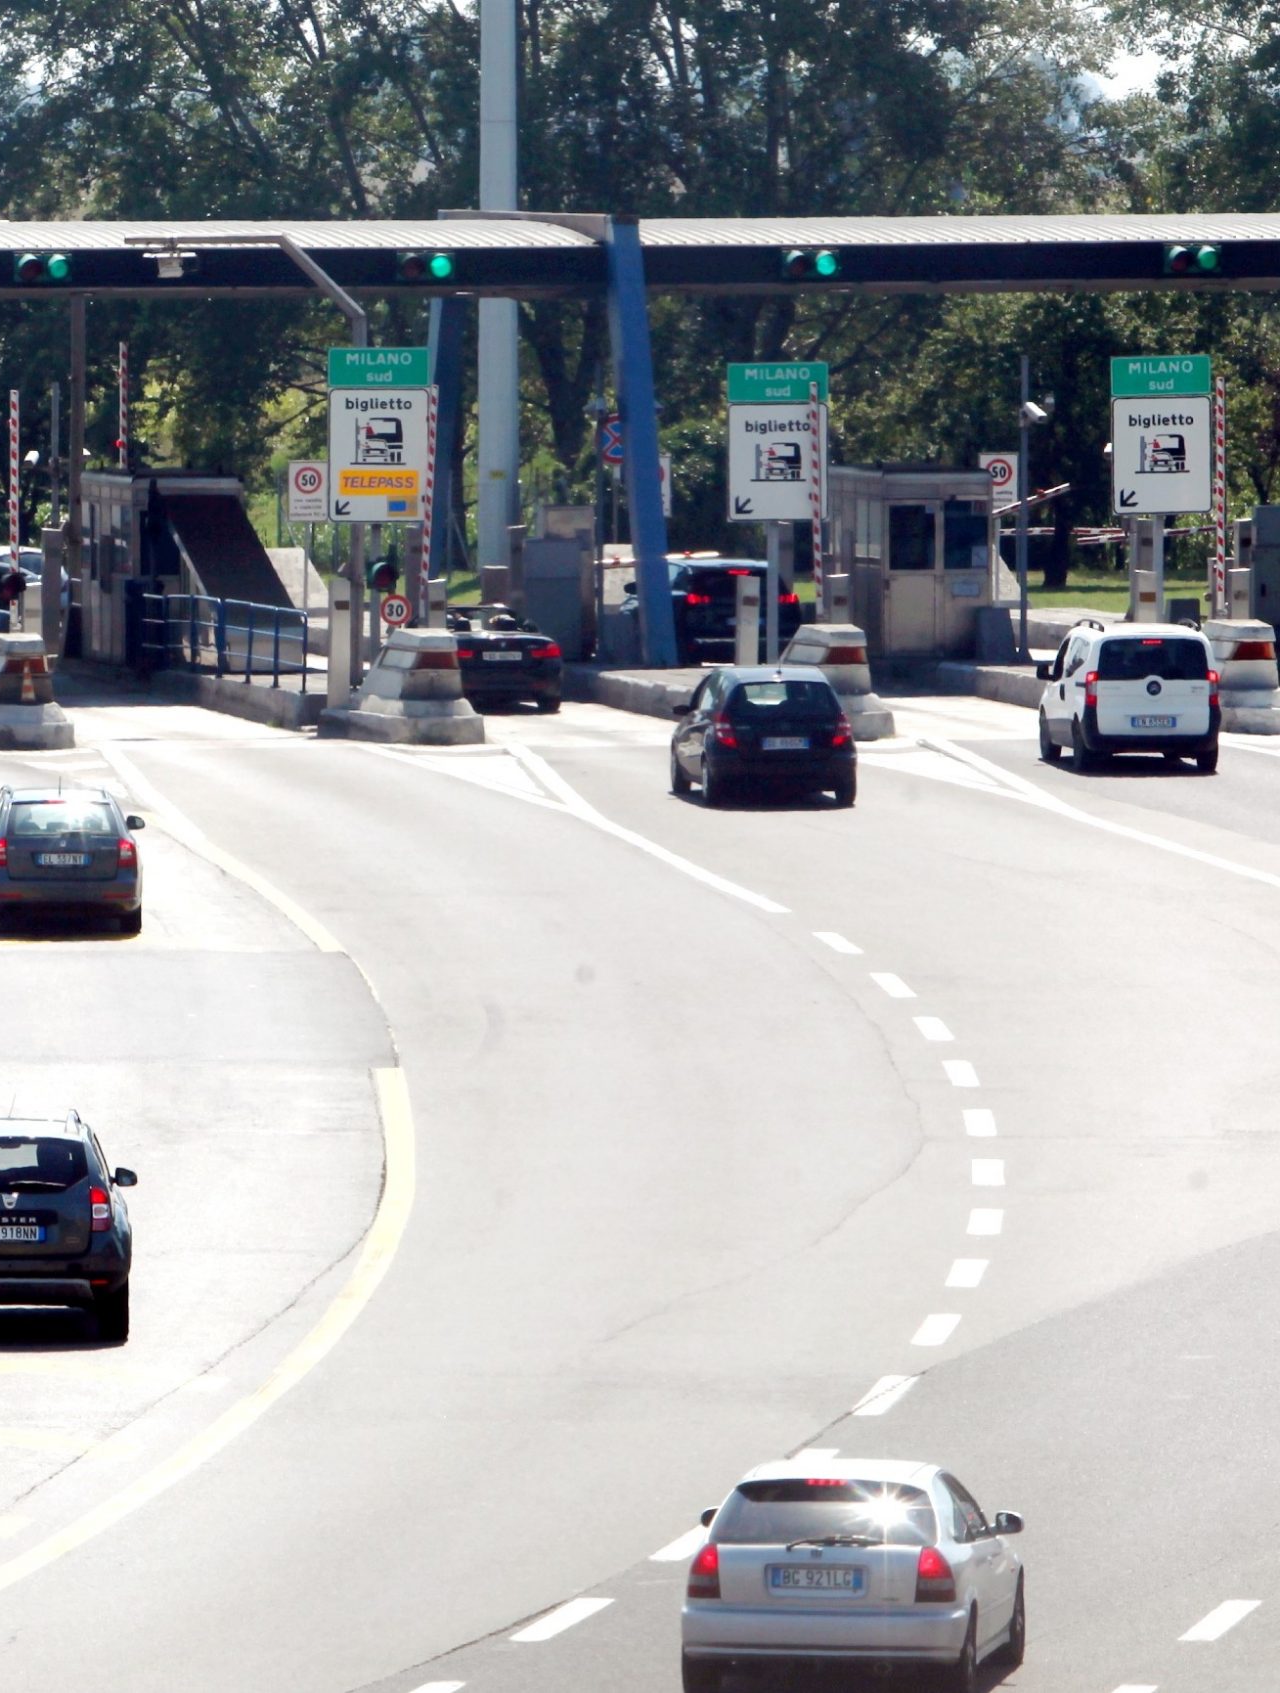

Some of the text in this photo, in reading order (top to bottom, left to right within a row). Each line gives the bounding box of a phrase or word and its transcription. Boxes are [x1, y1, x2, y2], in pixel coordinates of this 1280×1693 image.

[345, 352, 412, 365] MILANO
[1128, 360, 1194, 374] MILANO
[366, 370, 393, 382] sud
[744, 367, 811, 381] MILANO
[765, 384, 791, 397] sud
[1148, 378, 1175, 390] sud
[345, 397, 412, 412] biglietto
[744, 419, 811, 435] biglietto
[1128, 413, 1194, 429] biglietto
[991, 466, 1007, 479] 50
[301, 474, 317, 487] 50
[342, 476, 415, 489] TELEPASS
[386, 603, 404, 617] 30
[1, 1227, 38, 1240] 918NN
